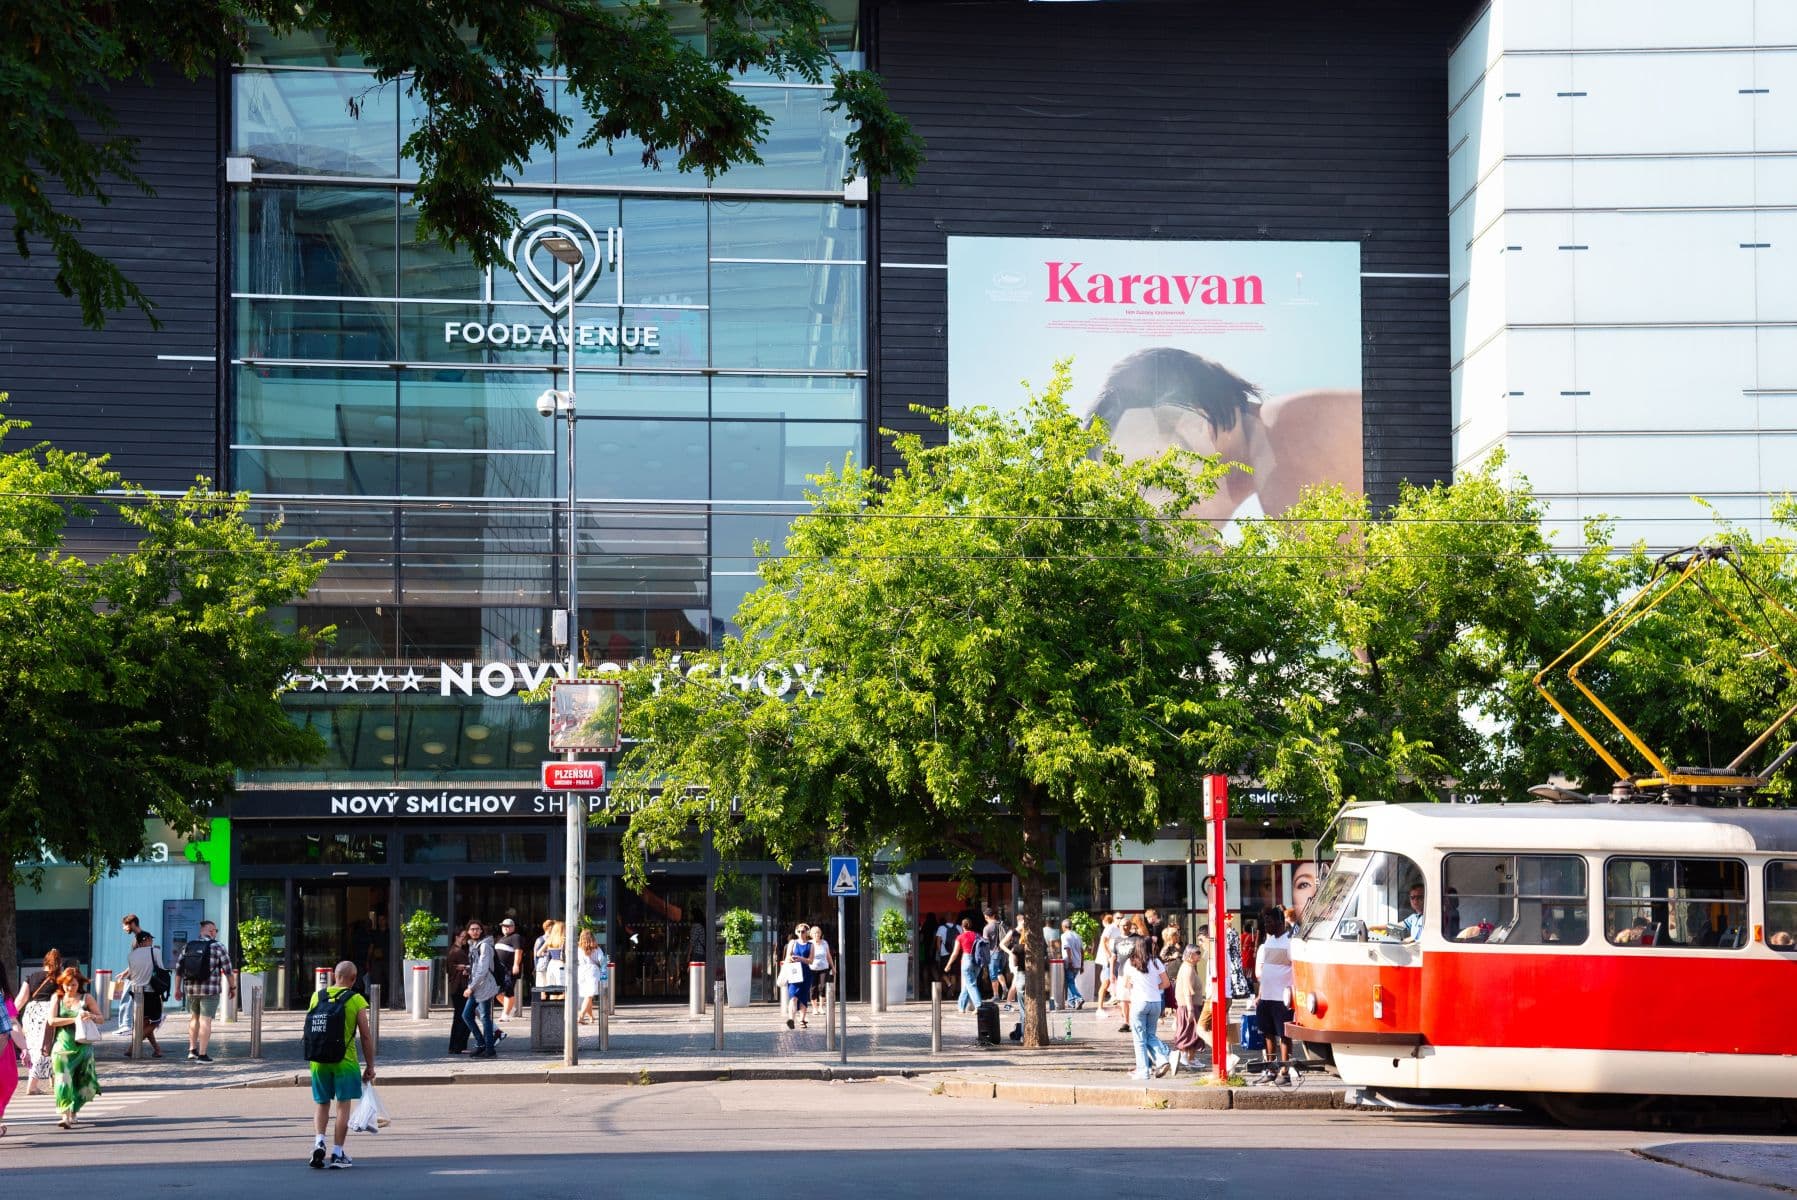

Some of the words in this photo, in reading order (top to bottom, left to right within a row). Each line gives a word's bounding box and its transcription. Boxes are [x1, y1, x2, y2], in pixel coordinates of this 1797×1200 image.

[1044, 261, 1266, 305] Karavan
[445, 322, 531, 344] FOOD
[538, 325, 659, 347] AVENUE
[554, 768, 593, 779] PLZEŇSKÁ
[331, 792, 399, 813] NOVÝ
[406, 792, 516, 813] SMÍCHOV
[1249, 791, 1304, 804] SMÍC
[1185, 843, 1243, 857] ARNI
